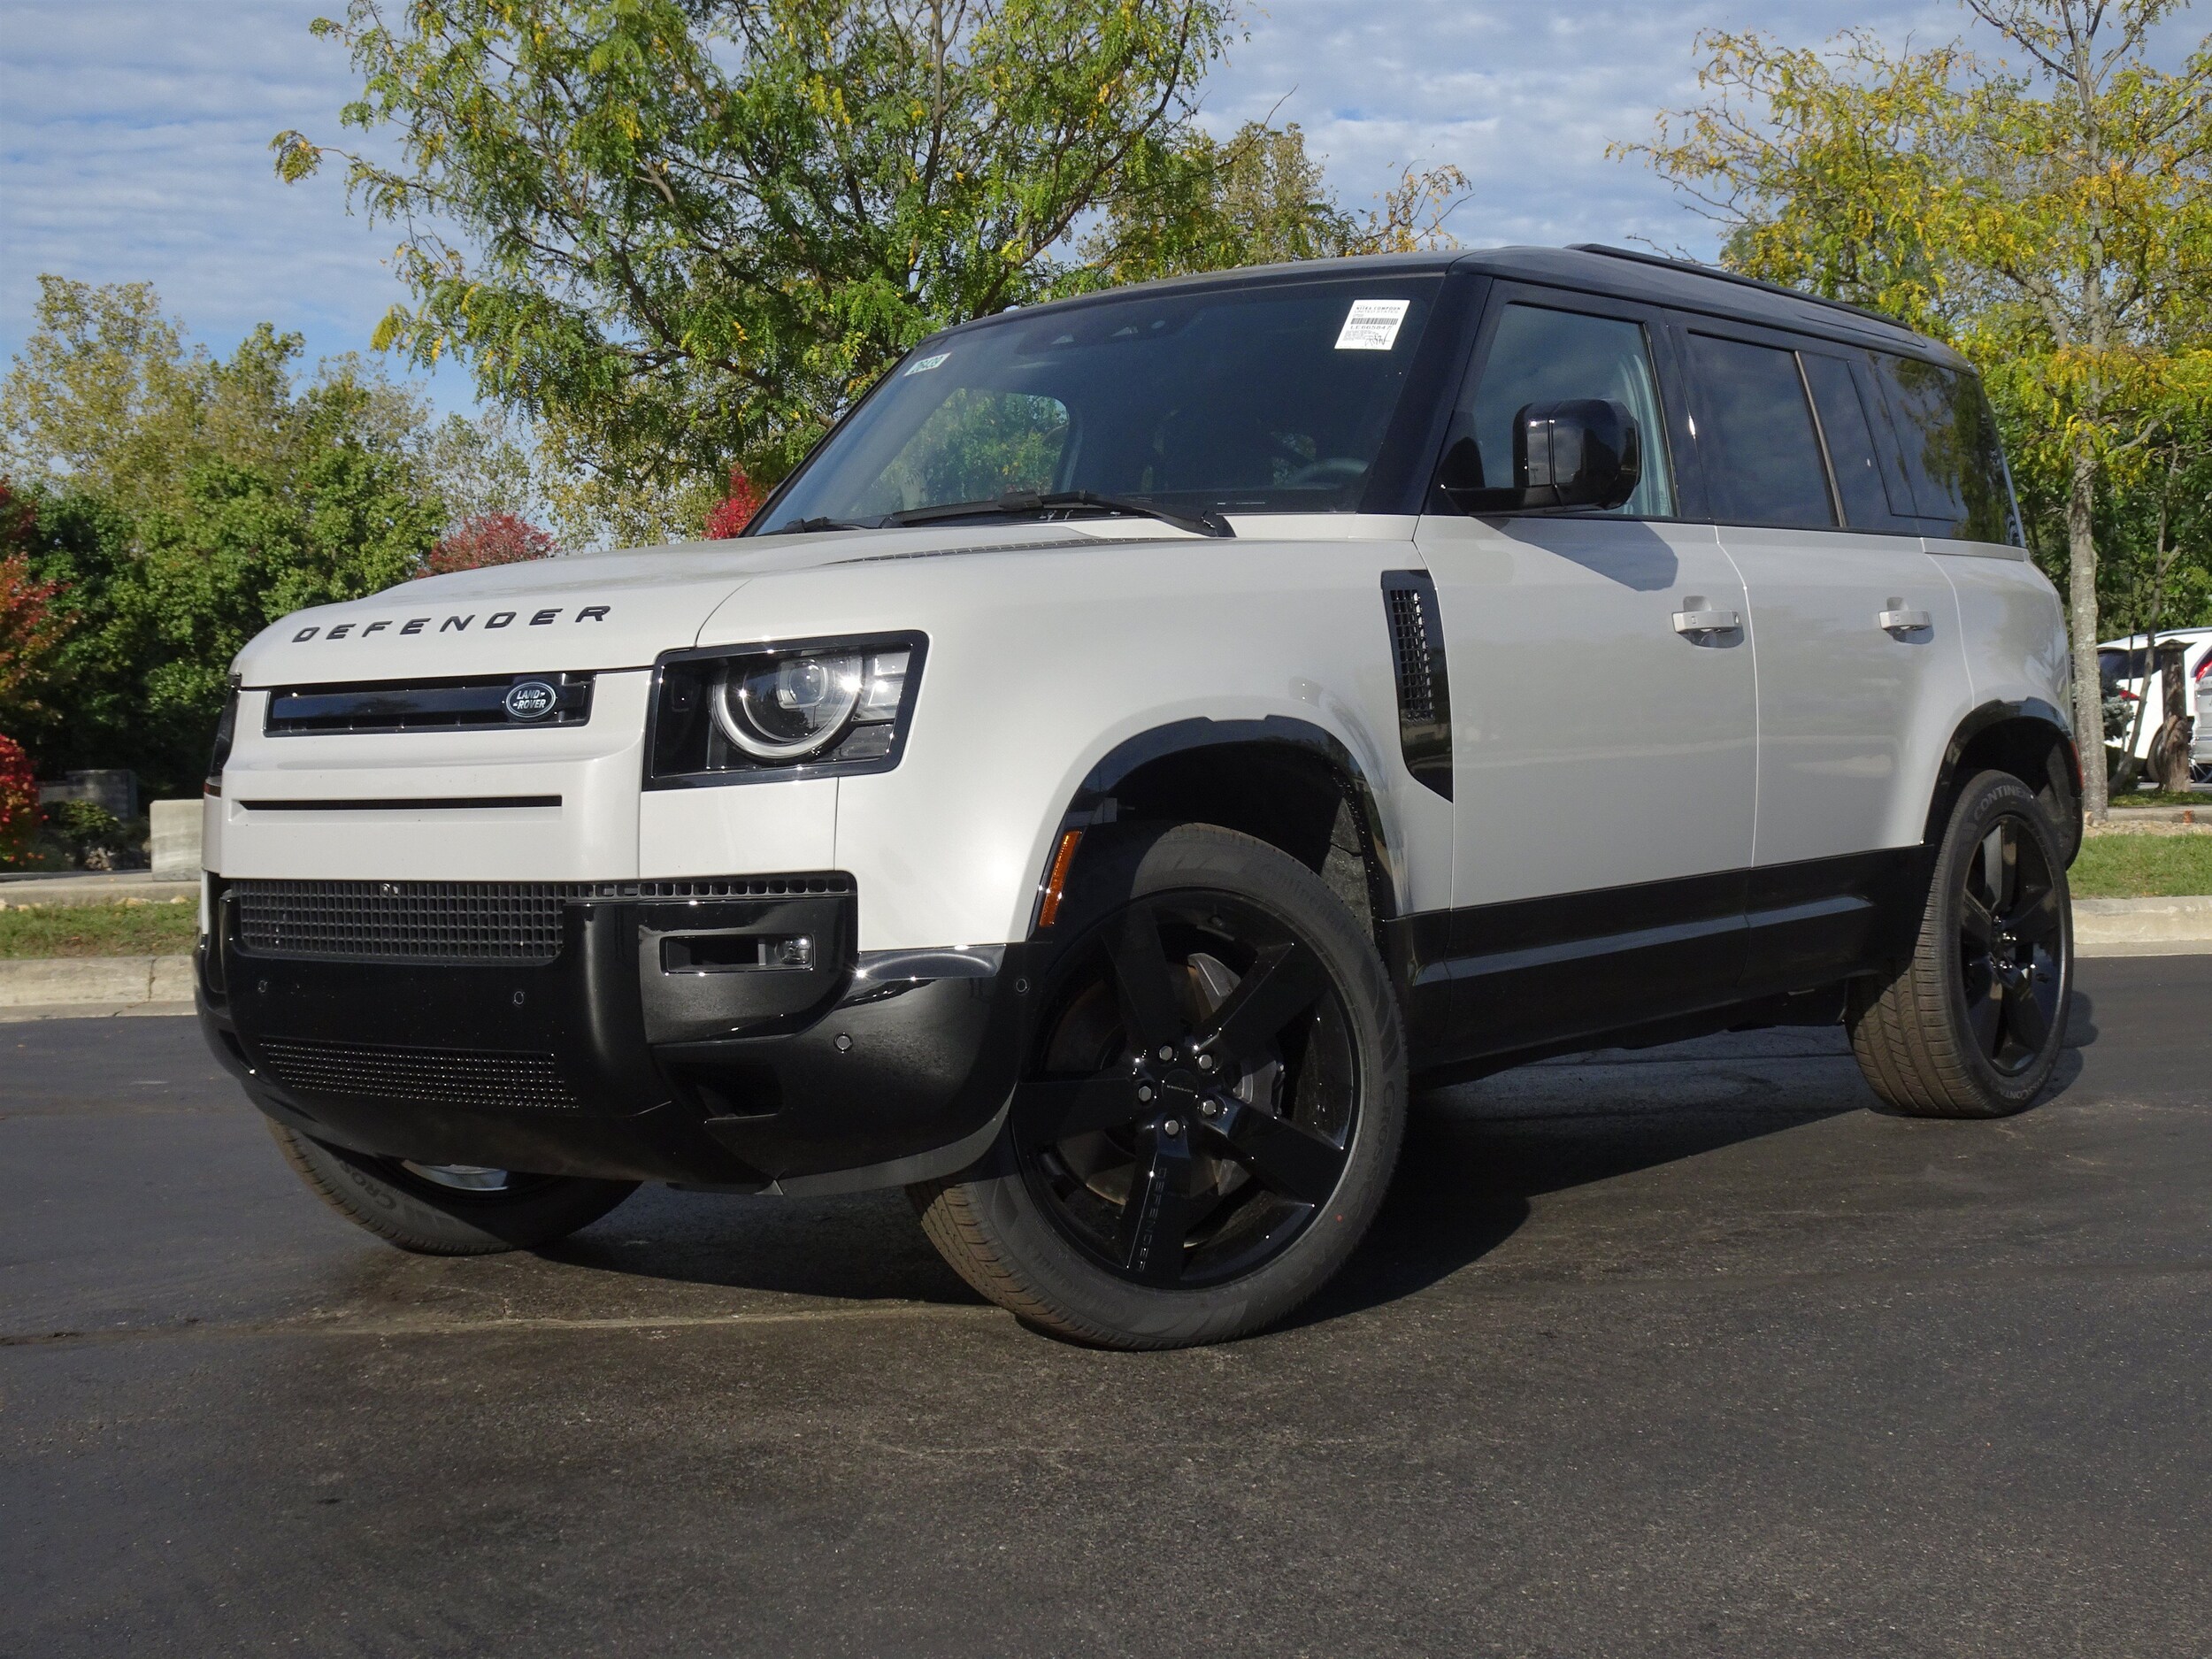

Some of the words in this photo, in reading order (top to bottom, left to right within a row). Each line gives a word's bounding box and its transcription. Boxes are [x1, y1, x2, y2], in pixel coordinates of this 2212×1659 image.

[292, 605, 611, 642] DEFENDER
[517, 690, 540, 699] LAND
[517, 699, 546, 709] ROVER
